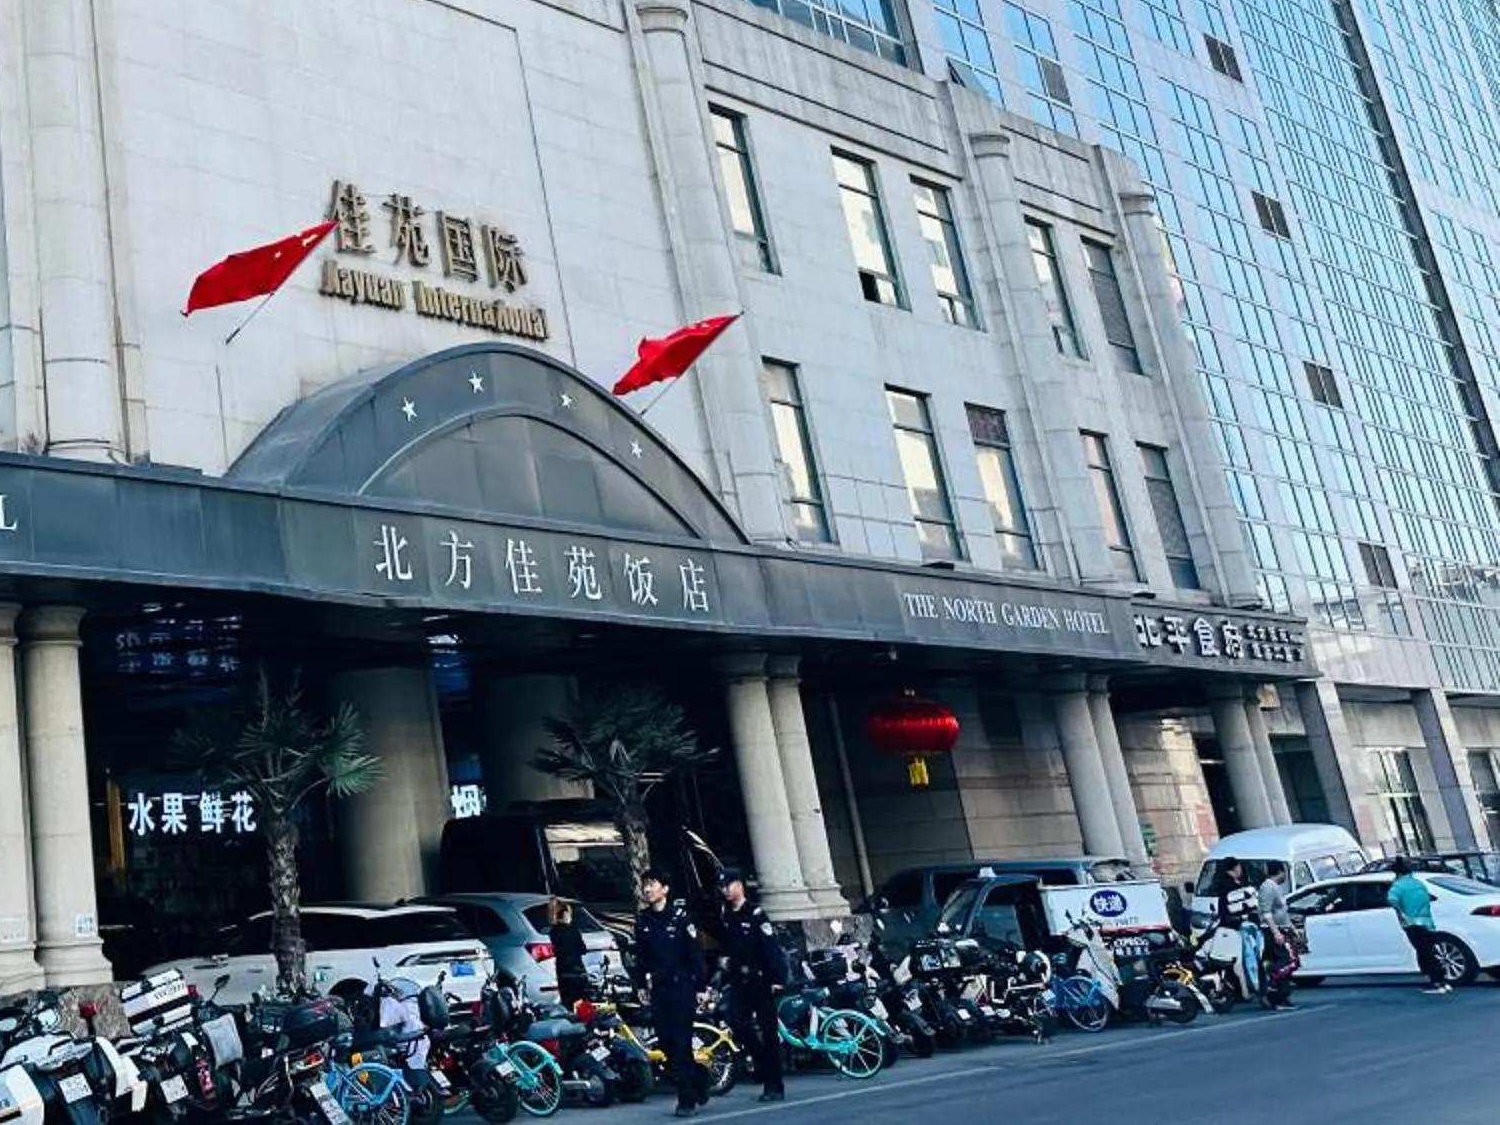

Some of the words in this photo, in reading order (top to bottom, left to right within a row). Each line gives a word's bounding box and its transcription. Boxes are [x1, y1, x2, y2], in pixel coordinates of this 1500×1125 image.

[325, 180, 529, 294] 佳苑国际
[412, 281, 549, 341] International
[373, 524, 709, 612] 北方佳苑饭店
[904, 593, 939, 619] THE
[942, 596, 998, 624] NORTH
[1001, 602, 1061, 630] GARDEN
[1063, 609, 1110, 634] HOTEL
[1133, 614, 1244, 659] 北平食府
[128, 790, 257, 836] 水果鲜花
[451, 784, 487, 819] 烟
